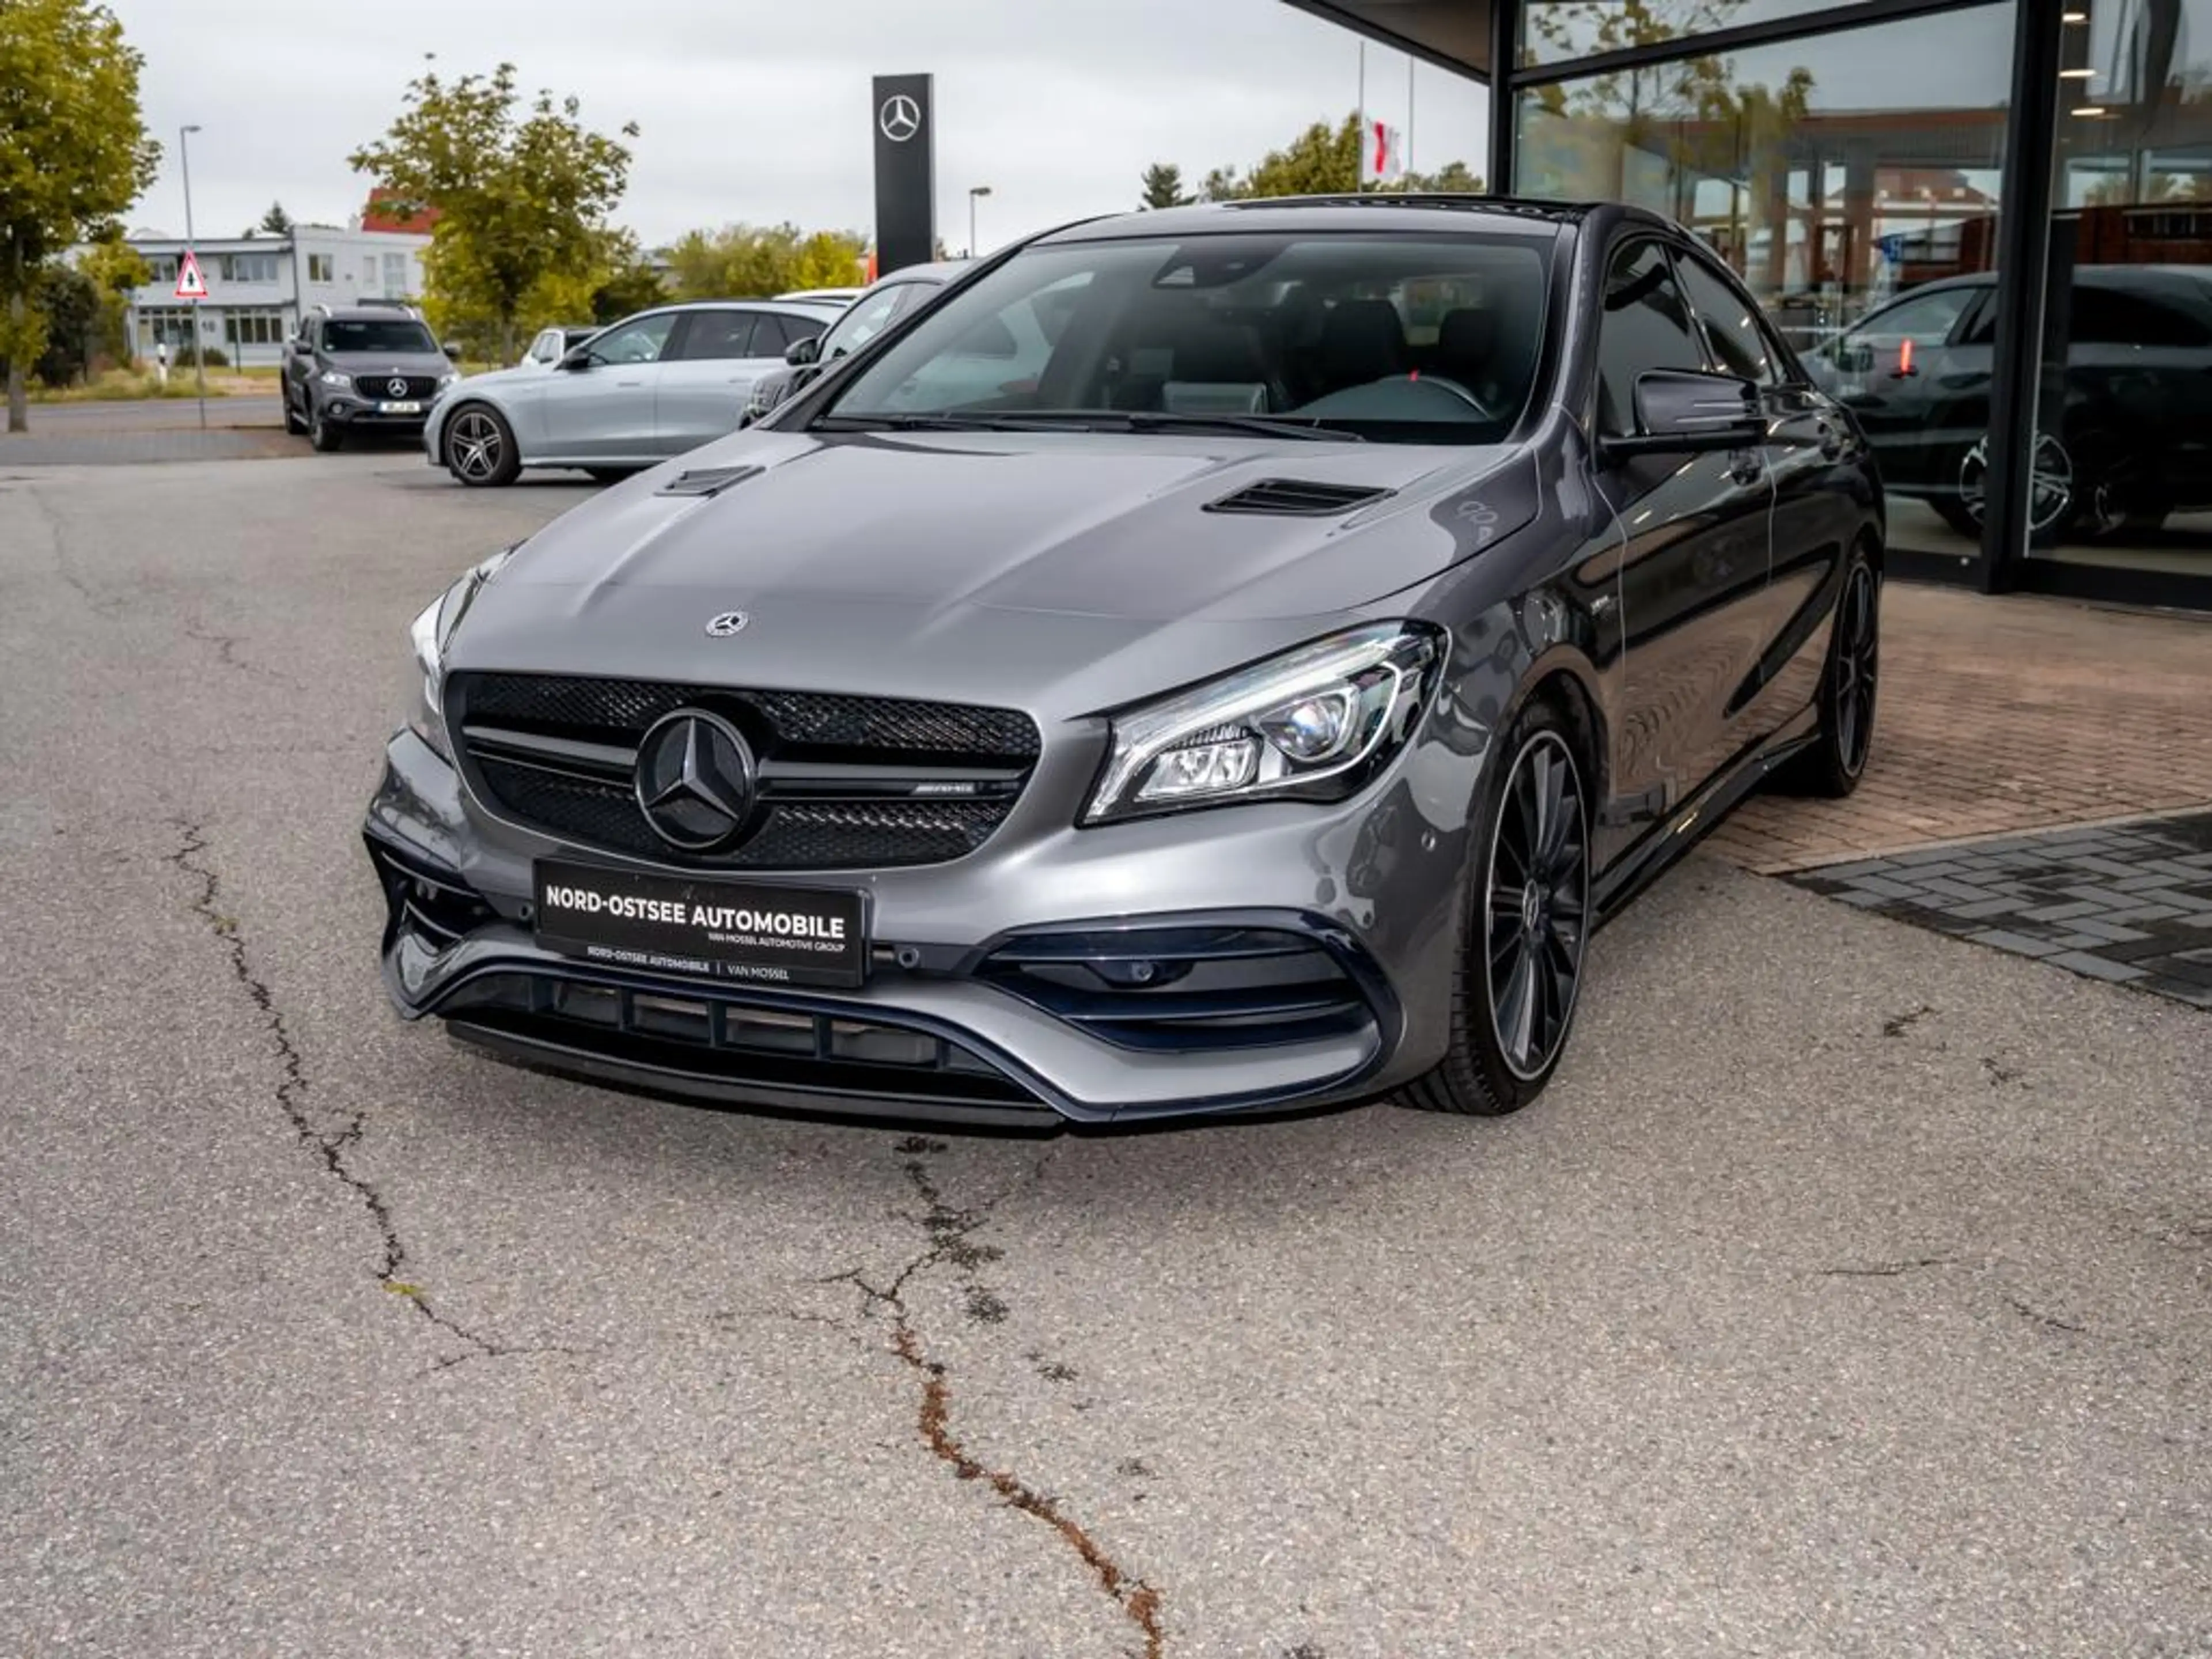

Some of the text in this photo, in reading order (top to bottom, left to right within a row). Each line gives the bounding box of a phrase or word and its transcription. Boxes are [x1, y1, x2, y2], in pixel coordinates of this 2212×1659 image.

[546, 885, 845, 939] NORD-OSTSEE AUTOMOBILE
[757, 937, 812, 951] AUTOMOTIVE
[815, 942, 845, 952] GROUP
[588, 946, 790, 980] NORD-OSTSEE AUTOMOBILE VAN MOSSEL
